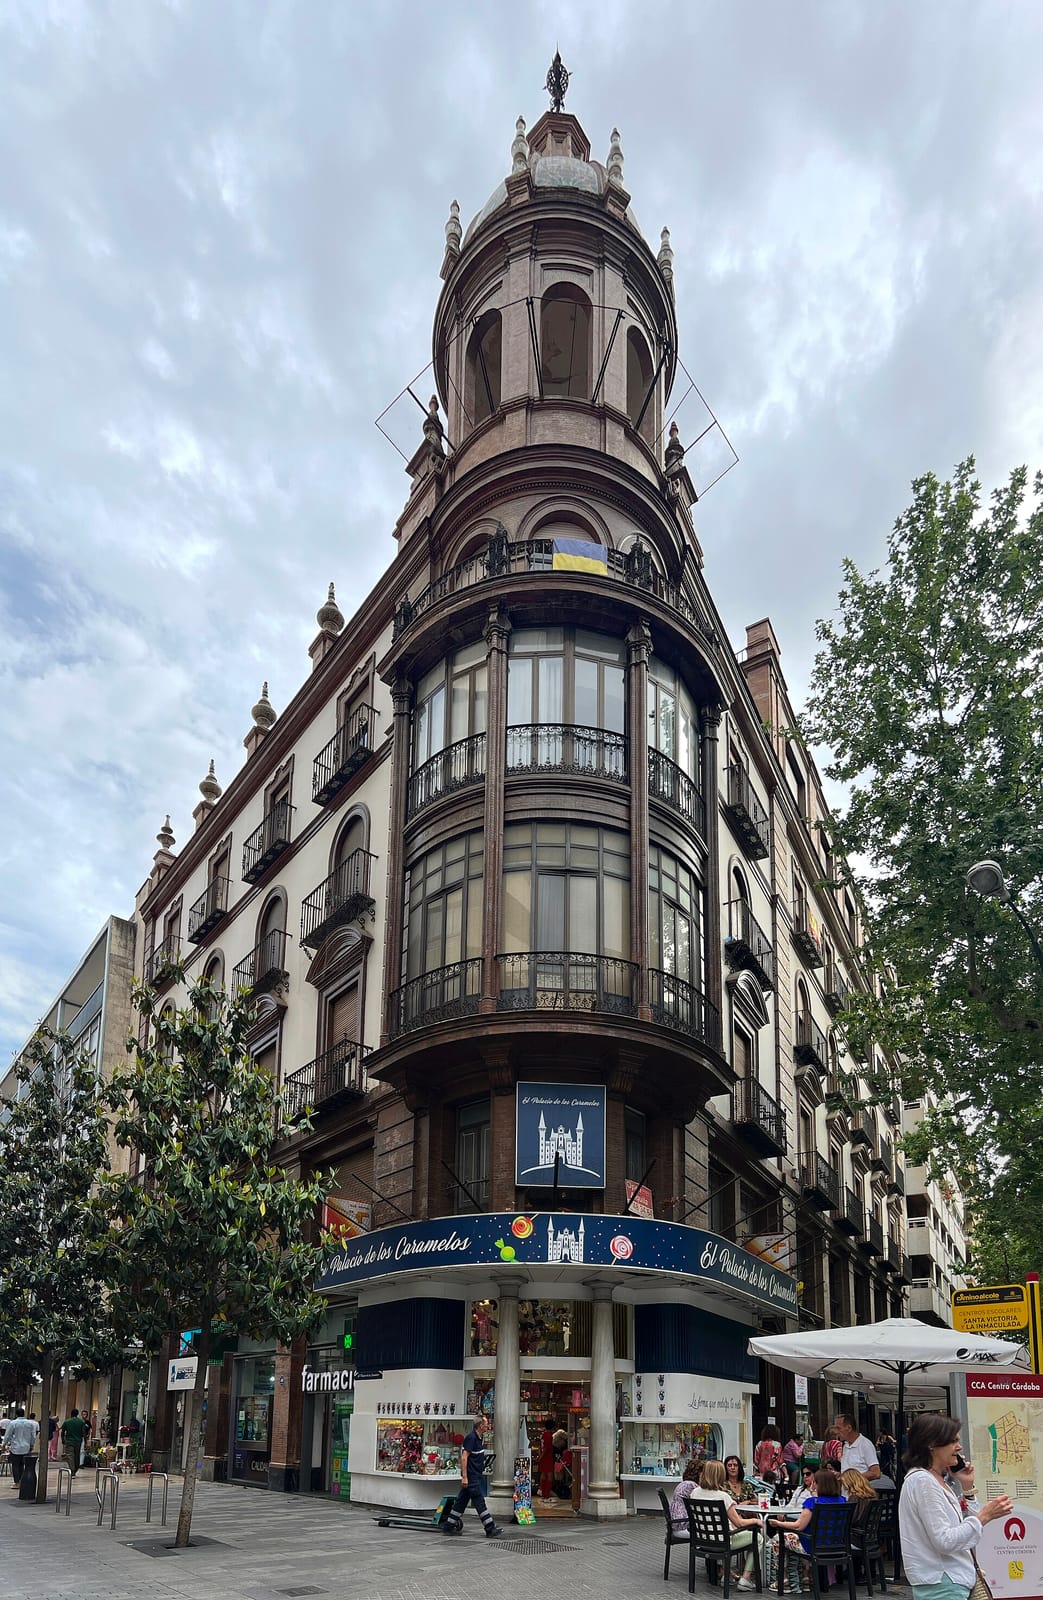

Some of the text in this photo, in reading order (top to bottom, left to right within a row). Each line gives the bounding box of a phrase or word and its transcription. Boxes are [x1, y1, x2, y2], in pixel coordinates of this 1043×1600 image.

[522, 1096, 530, 1104] El
[571, 1099, 600, 1107] Caramelos
[330, 1251, 363, 1276] Palacio
[364, 1244, 377, 1265] de
[376, 1242, 392, 1262] los
[394, 1231, 472, 1260] Caramelos
[700, 1240, 797, 1304] El Palacio de los Caramelos
[972, 1353, 1000, 1362] MAX
[302, 1364, 354, 1392] farmaci
[971, 1381, 1040, 1391] CCA Centro Córdoba
